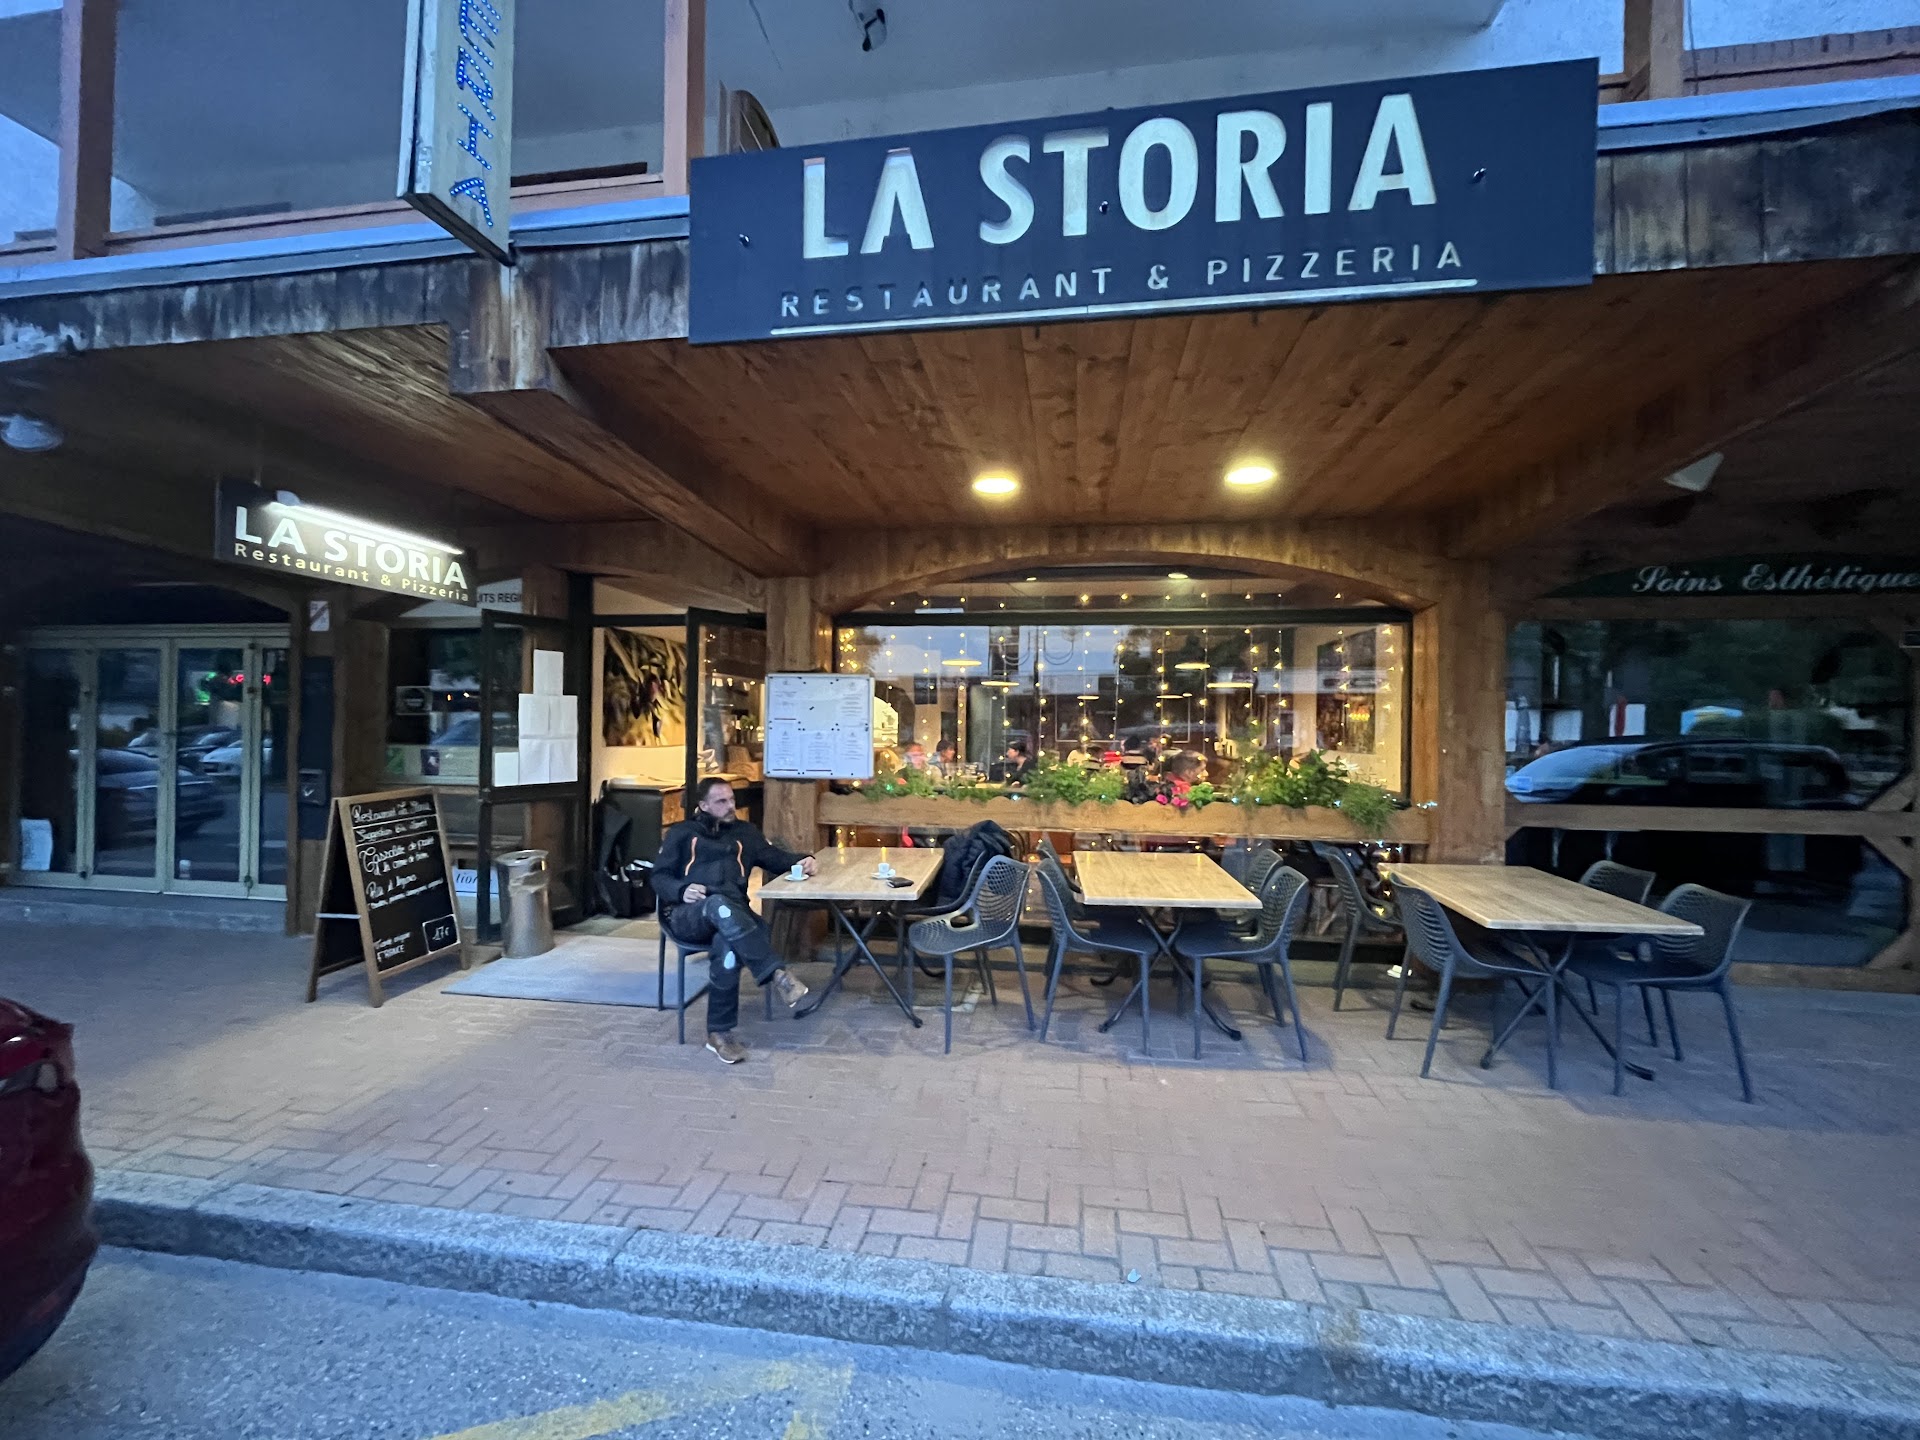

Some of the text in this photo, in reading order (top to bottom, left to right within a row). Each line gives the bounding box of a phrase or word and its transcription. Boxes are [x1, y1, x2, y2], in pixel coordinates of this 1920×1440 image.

[450, 0, 501, 227] ERIA
[803, 93, 1438, 259] LA STORIA
[780, 241, 1461, 318] RESTAURANT & PIZZERIA
[234, 543, 468, 601] Restaurant & Pizzeria
[235, 506, 468, 589] LA STORIA
[1632, 565, 1723, 592] Soins
